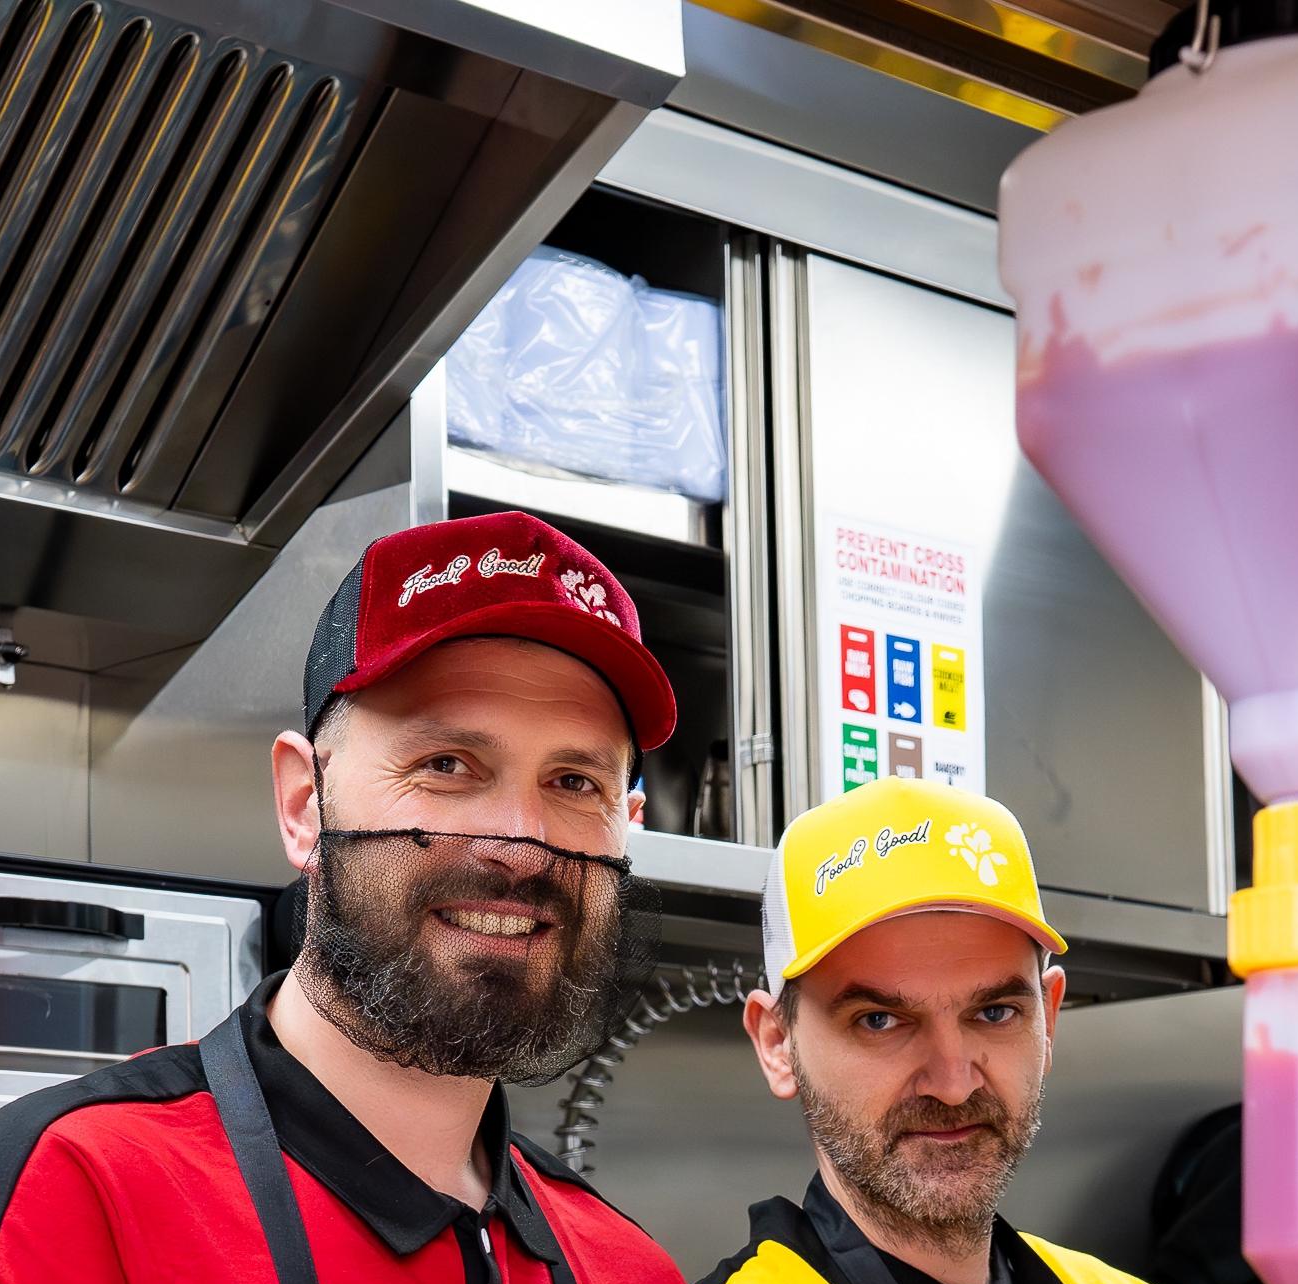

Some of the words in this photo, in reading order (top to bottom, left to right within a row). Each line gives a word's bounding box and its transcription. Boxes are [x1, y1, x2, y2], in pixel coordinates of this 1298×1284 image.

[836, 527, 908, 560] PREVENT
[914, 546, 964, 574] CROSS
[837, 550, 965, 596] CONTAMINATION
[398, 555, 471, 607] Food?
[478, 548, 546, 578] Good!
[815, 838, 867, 895] Food?
[876, 819, 931, 857] Good!
